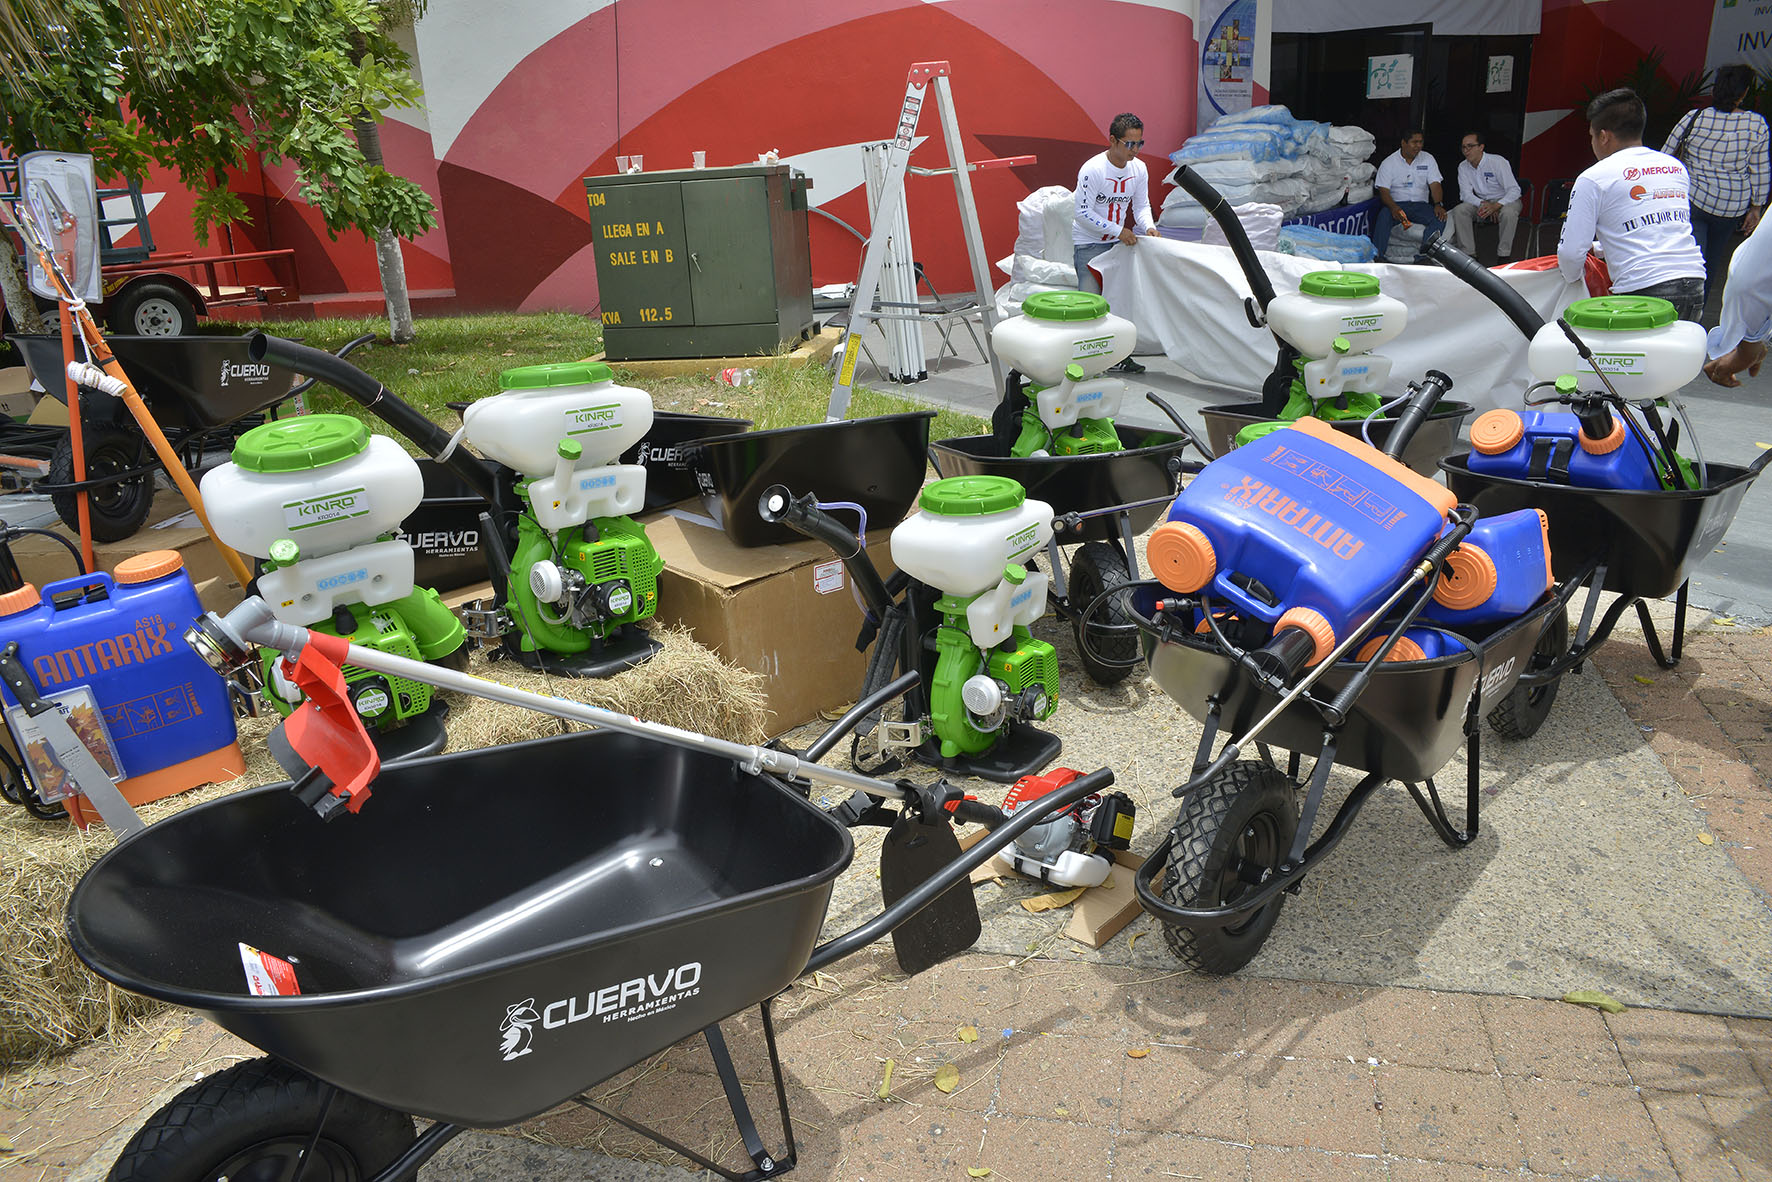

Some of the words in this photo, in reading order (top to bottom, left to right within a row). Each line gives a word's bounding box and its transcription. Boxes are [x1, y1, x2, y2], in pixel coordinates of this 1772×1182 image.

[1642, 166, 1682, 176] MERCURY
[587, 193, 606, 207] T04
[603, 223, 632, 239] LLEGA
[636, 222, 650, 237] EN
[656, 221, 664, 236] A
[1622, 218, 1639, 232] TU
[1640, 211, 1673, 227] MEJOR
[610, 251, 637, 266] SALE
[642, 250, 659, 264] EN
[665, 249, 674, 263] B
[601, 311, 622, 325] KVA
[640, 307, 673, 322] 112.5
[1348, 318, 1377, 327] KINRO
[1080, 341, 1109, 351] KINRO
[230, 364, 270, 378] CUERVO
[1594, 357, 1635, 368] INRO
[576, 410, 614, 424] KINRO
[298, 496, 355, 517] KINRO
[1223, 493, 1253, 510] AS18
[1229, 475, 1365, 561] ANTARIX
[1012, 529, 1036, 548] KINRO
[425, 546, 478, 555] HERRAMIENTAS
[135, 614, 162, 631] AS18
[33, 623, 173, 688] ANTARIX
[358, 696, 385, 707] KINRO
[543, 961, 702, 1030] CUERVO
[602, 987, 700, 1024] HERRAMIENTAS
[627, 1013, 646, 1023] Hecho
